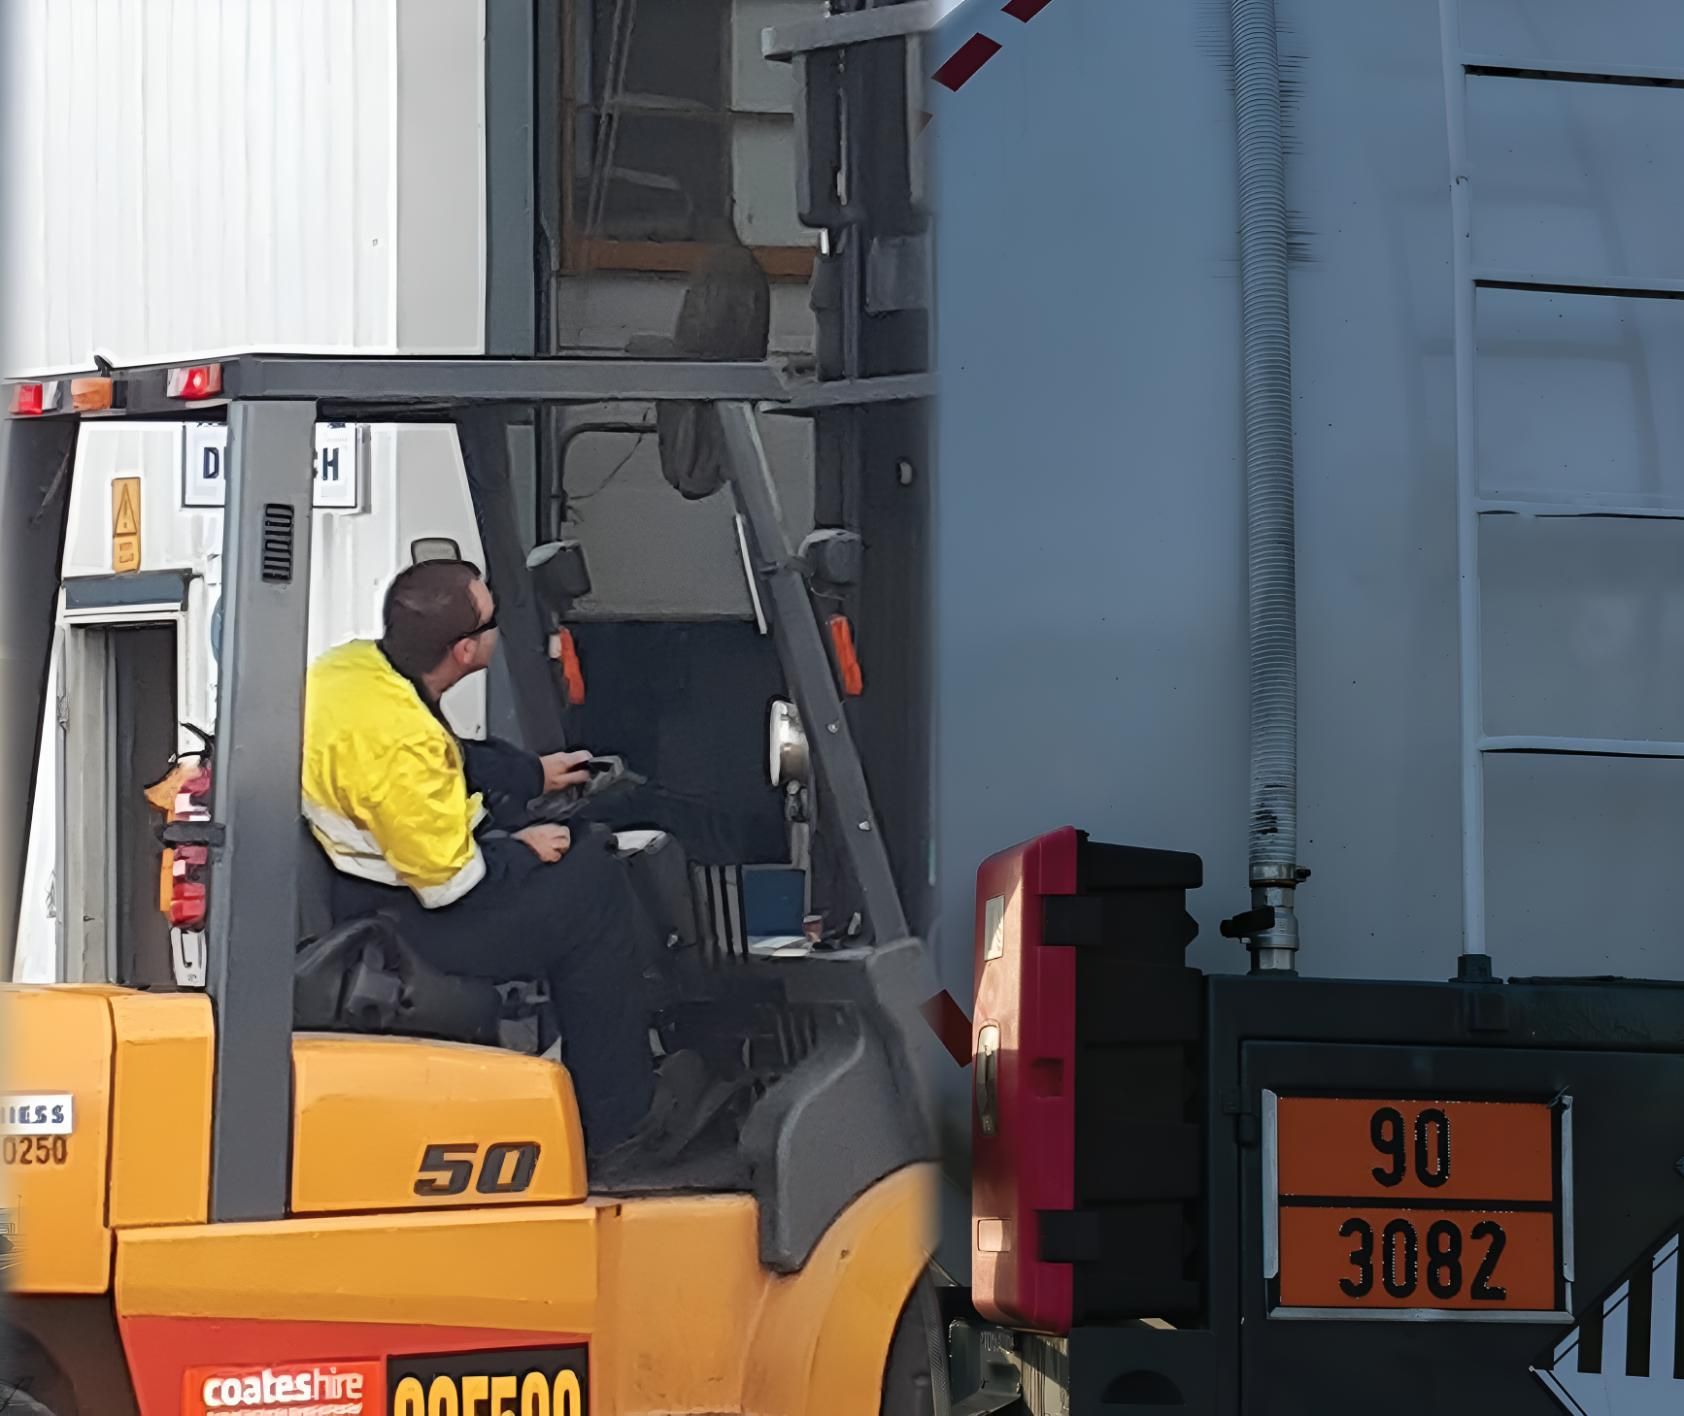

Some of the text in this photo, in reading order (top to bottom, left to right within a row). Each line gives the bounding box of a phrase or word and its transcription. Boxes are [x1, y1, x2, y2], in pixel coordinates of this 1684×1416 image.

[414, 1142, 541, 1195] 50
[1370, 1107, 1450, 1188] 90
[1338, 1217, 1507, 1301] 3082
